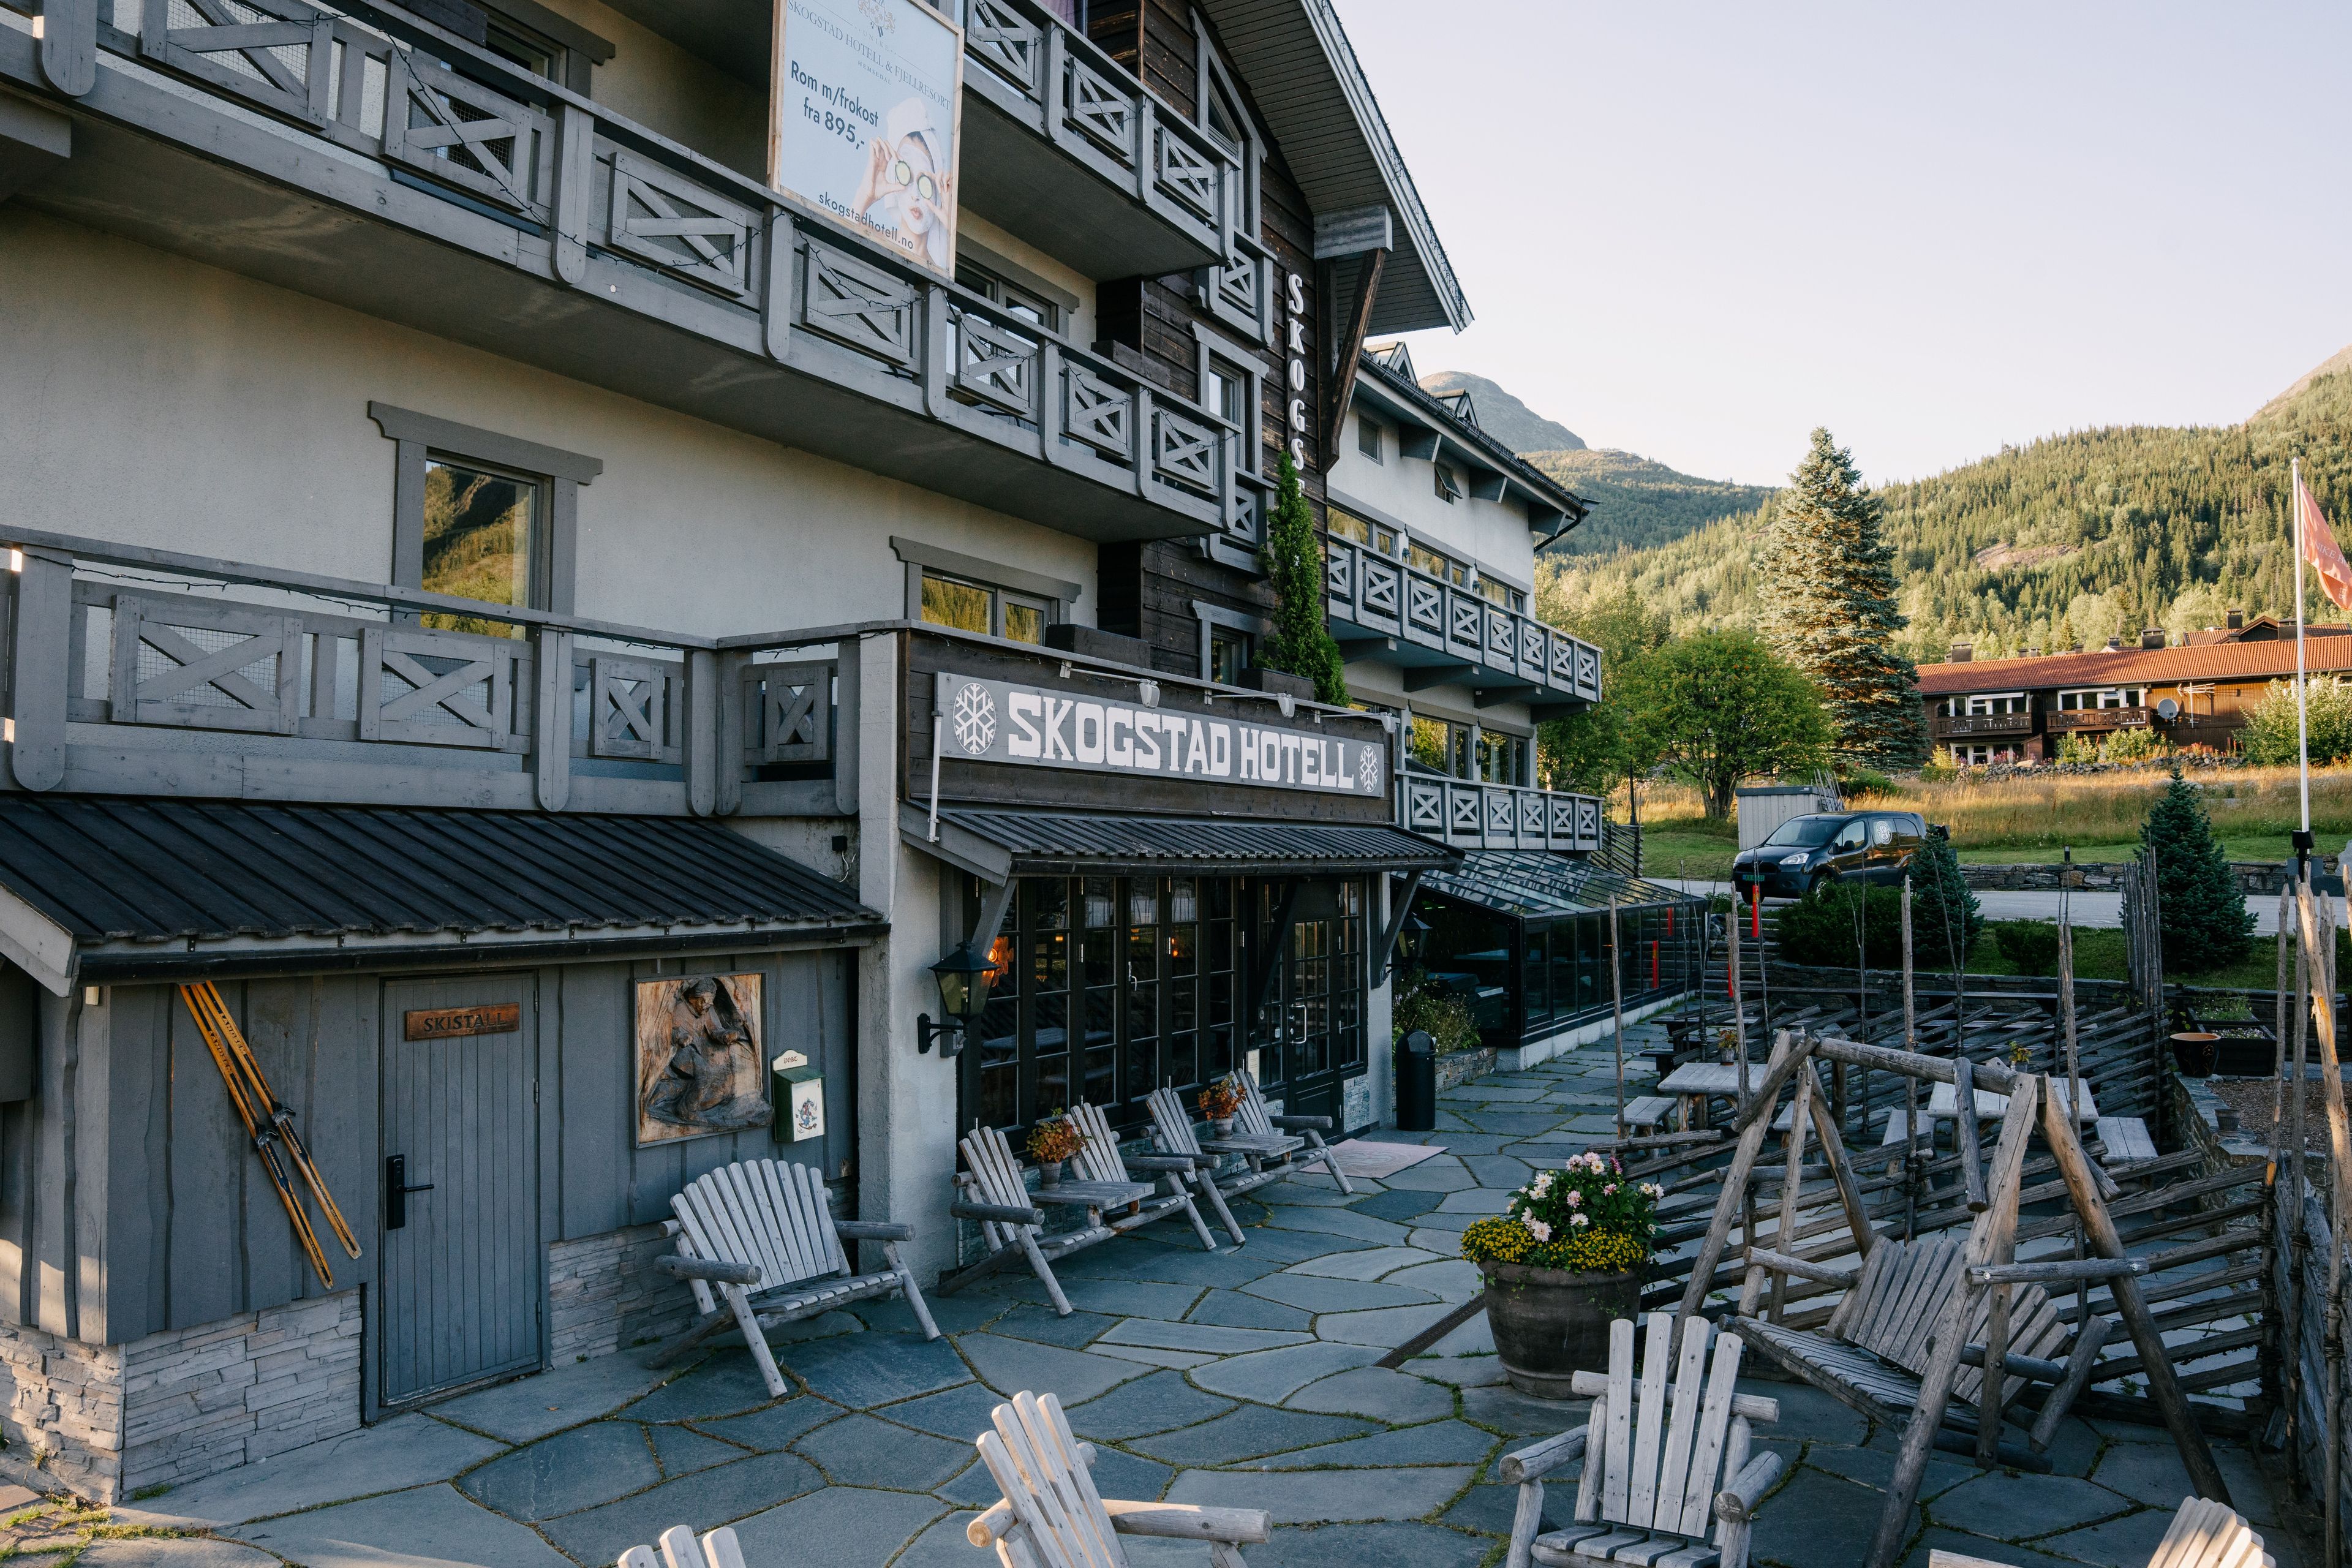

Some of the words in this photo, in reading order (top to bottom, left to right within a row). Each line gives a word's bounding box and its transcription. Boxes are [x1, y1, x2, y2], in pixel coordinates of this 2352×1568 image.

[788, 0, 843, 40] SKOGSTAD
[846, 34, 884, 68] HOTELL
[886, 61, 892, 73] &
[895, 66, 951, 111] FJELLRESORT
[858, 60, 891, 85] HEMSEDAL
[791, 60, 817, 92] Rom
[822, 84, 878, 127] m/frokost
[804, 97, 820, 124] fra
[824, 111, 864, 150] 895,-
[819, 192, 913, 249] skogstadhotell.no
[1008, 691, 1231, 776] SKOGSTAD
[1239, 727, 1355, 790] HOTELL
[424, 1012, 507, 1032] SKISTALL
